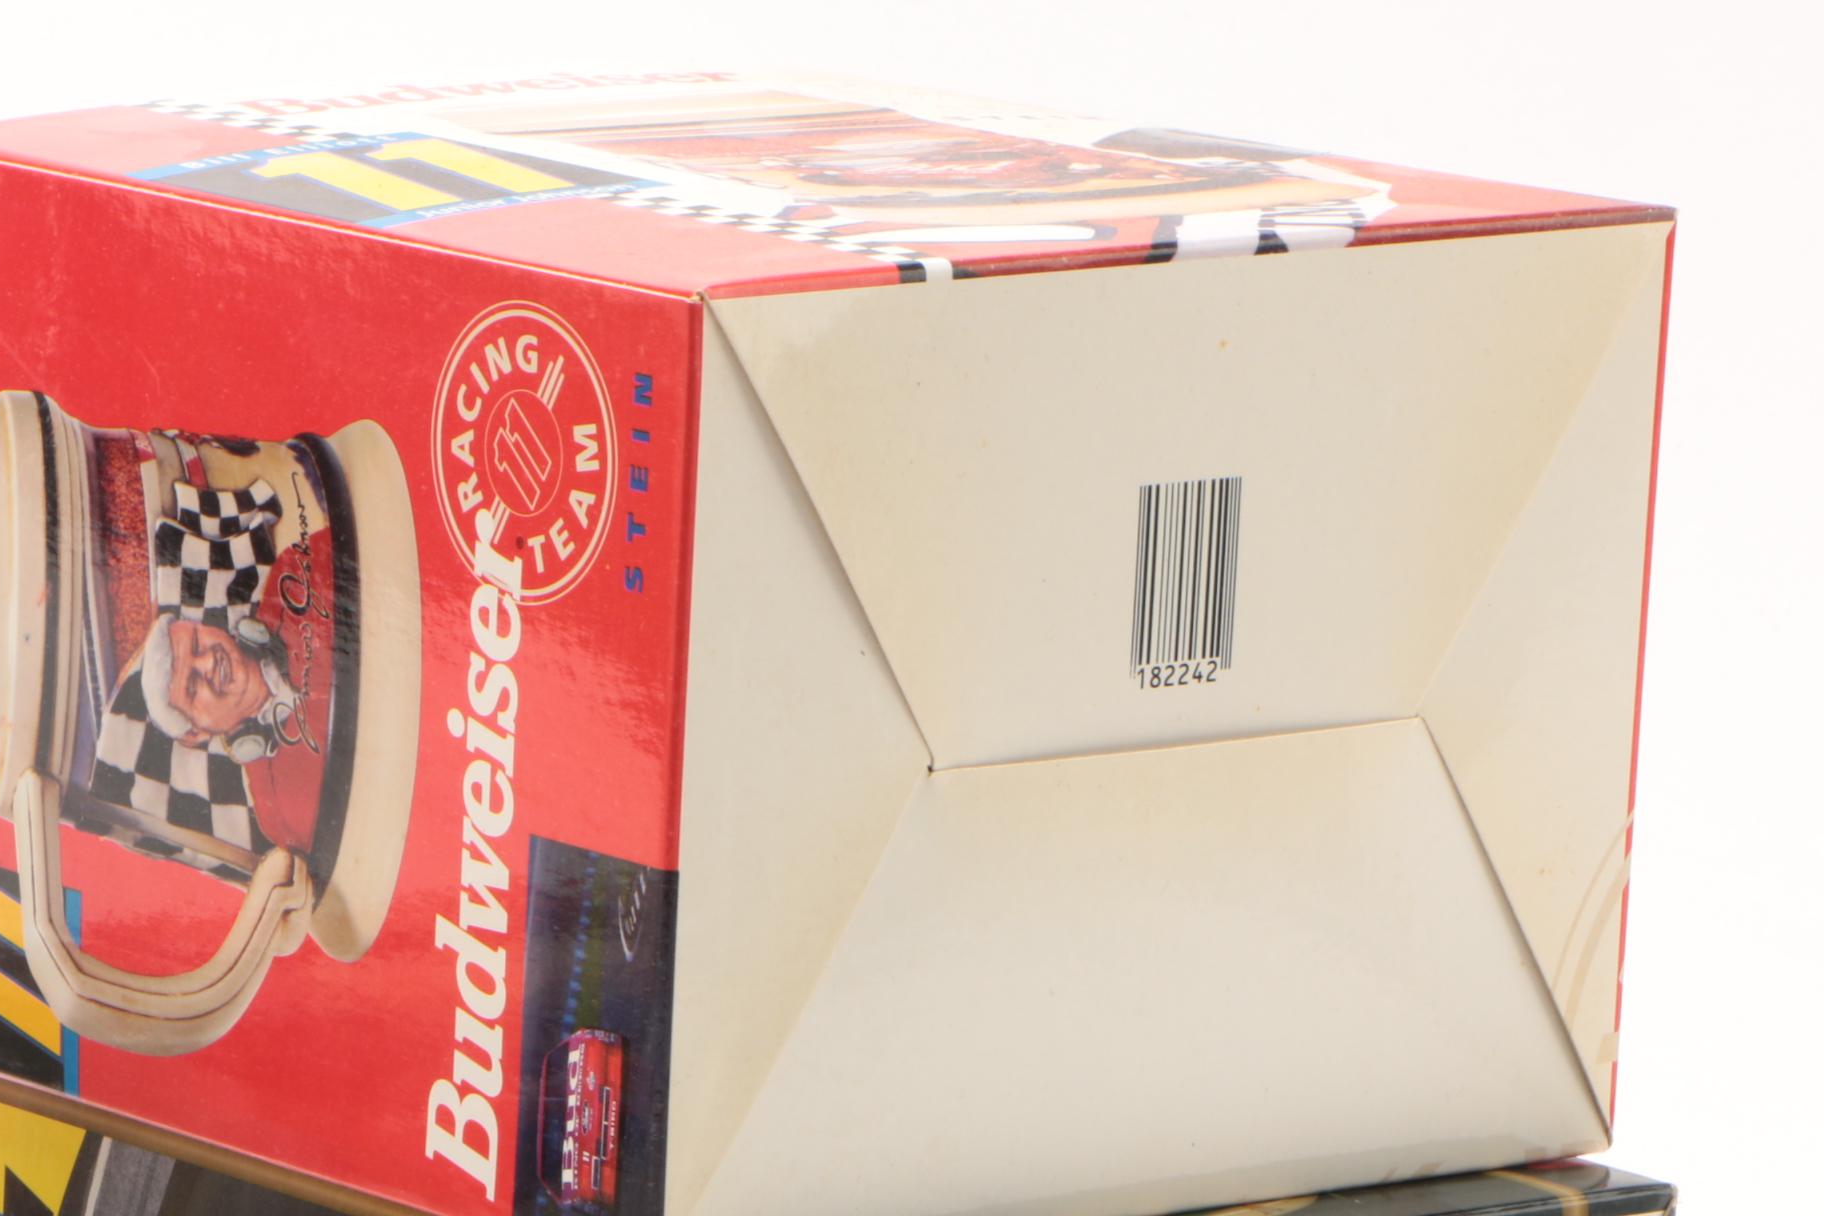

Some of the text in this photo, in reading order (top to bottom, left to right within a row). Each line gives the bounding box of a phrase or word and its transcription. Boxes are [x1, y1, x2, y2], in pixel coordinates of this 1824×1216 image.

[233, 71, 743, 117] Budweiser
[249, 138, 578, 211] 11
[450, 334, 540, 514] RACING
[528, 422, 602, 574] TEAM
[624, 372, 654, 593] STEIN
[1137, 660, 1217, 689] 182242
[422, 507, 524, 1203] Budweiser
[561, 1047, 581, 1191] Bud
